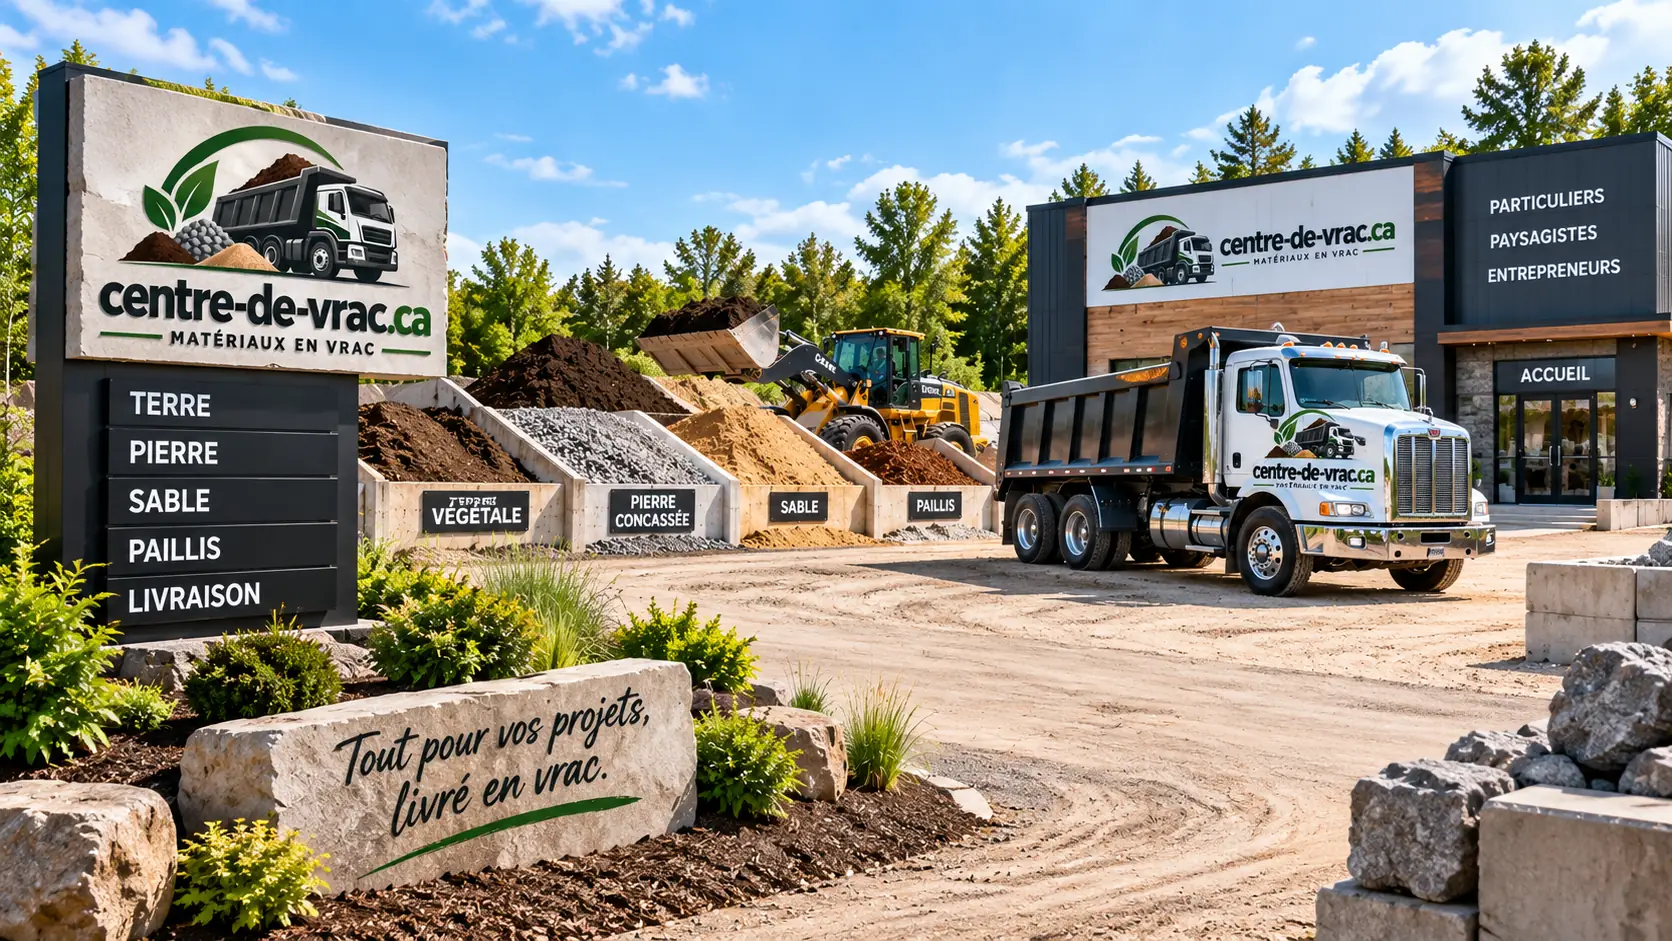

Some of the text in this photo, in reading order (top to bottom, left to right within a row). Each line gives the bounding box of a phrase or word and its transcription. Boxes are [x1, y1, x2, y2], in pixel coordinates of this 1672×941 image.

[1490, 188, 1605, 215] PARTICULIERS
[1219, 221, 1396, 257] centre-de-vrac.ca
[1490, 224, 1598, 249] PAYSAGISTES
[1253, 248, 1359, 265] MATÉRIAUX EN VRAC
[1488, 258, 1621, 283] ENTREPRENEURS
[98, 279, 432, 338] centre-de-vrac.ca
[170, 329, 375, 356] MATÉRIAUX EN VRAC
[1520, 365, 1591, 383] ACCUEIL
[129, 390, 211, 418] TERRE
[130, 439, 219, 465] PIERRE
[1252, 462, 1376, 484] centre-de-vrac.ca
[128, 488, 210, 514] SABLE
[630, 494, 676, 510] PIERRE
[780, 500, 819, 514] SABLE
[916, 498, 955, 513] PAILLIS
[615, 511, 690, 528] CONCASSÉE
[129, 536, 221, 563] PAILLIS
[128, 581, 261, 614] LIVRAISON
[335, 687, 651, 787] Tout pour vos projets,
[391, 754, 608, 838] livré en vrac.
